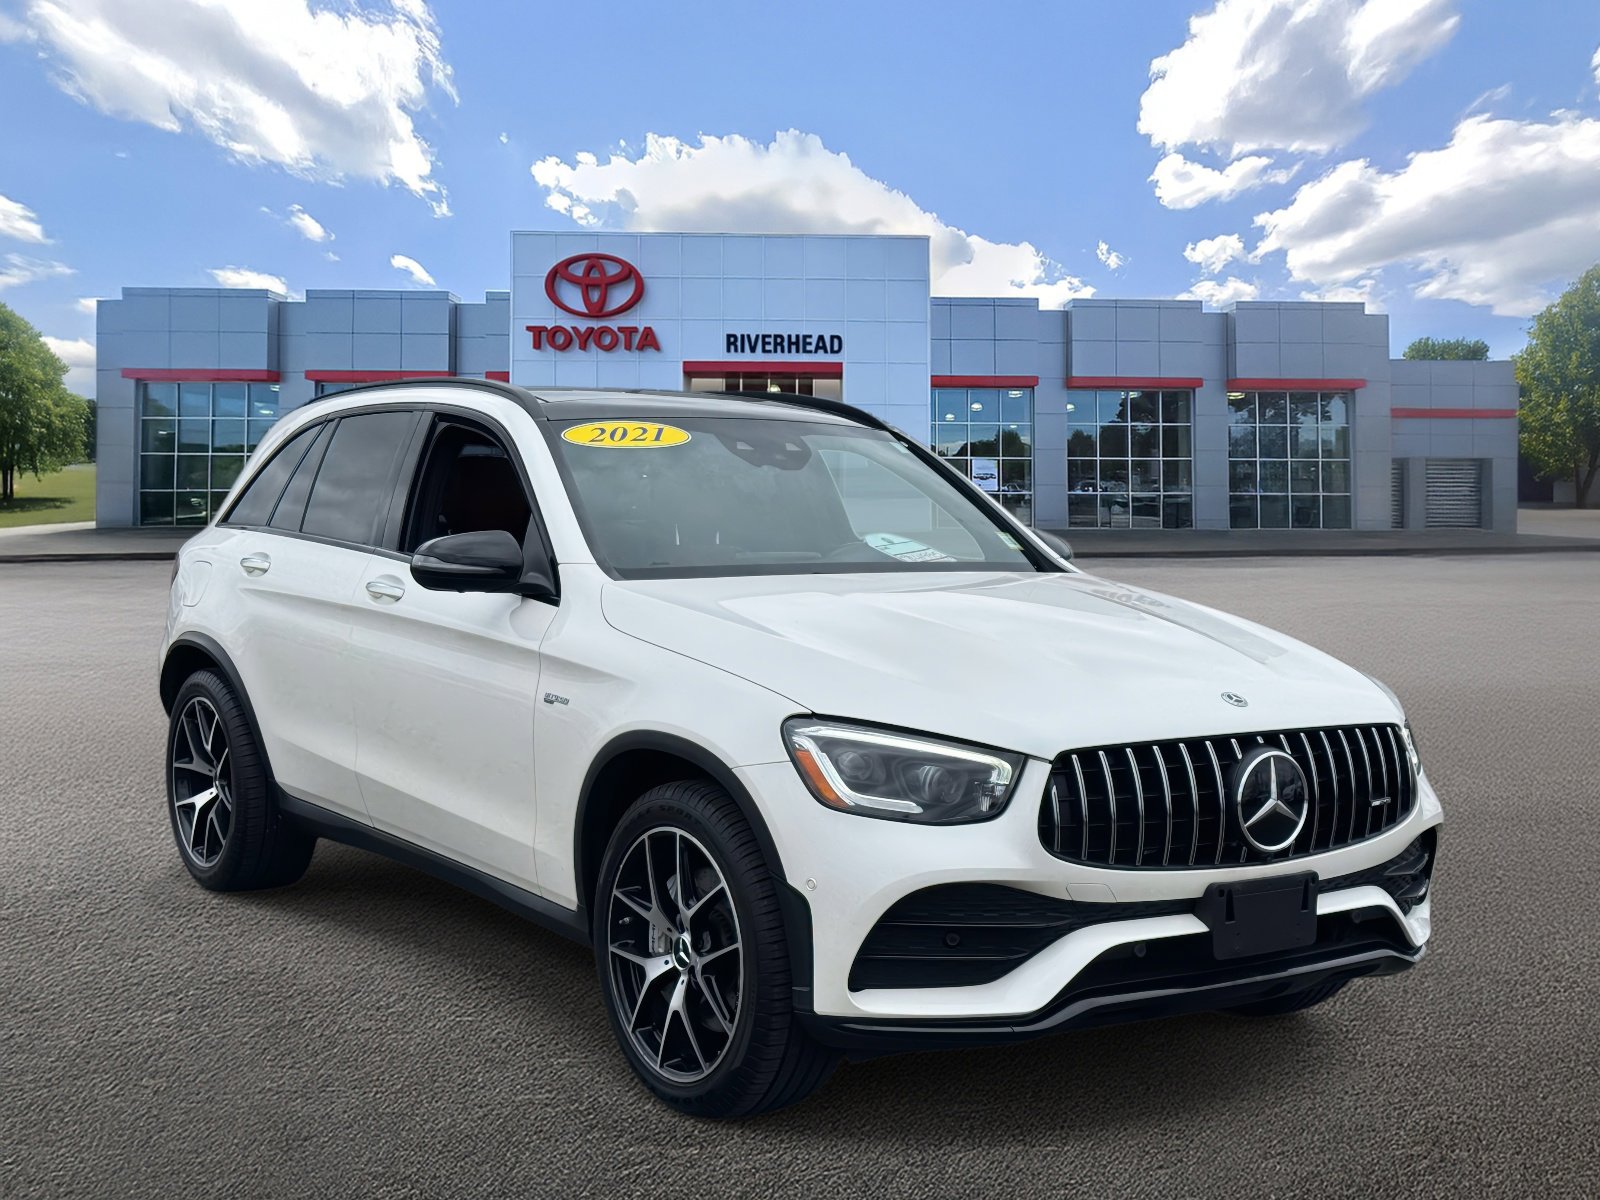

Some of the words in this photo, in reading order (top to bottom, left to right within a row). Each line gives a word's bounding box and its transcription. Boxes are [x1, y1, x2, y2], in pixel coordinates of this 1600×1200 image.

[526, 325, 660, 351] TOYOTA
[726, 333, 843, 354] RIVERHEAD
[589, 426, 664, 442] 2021
